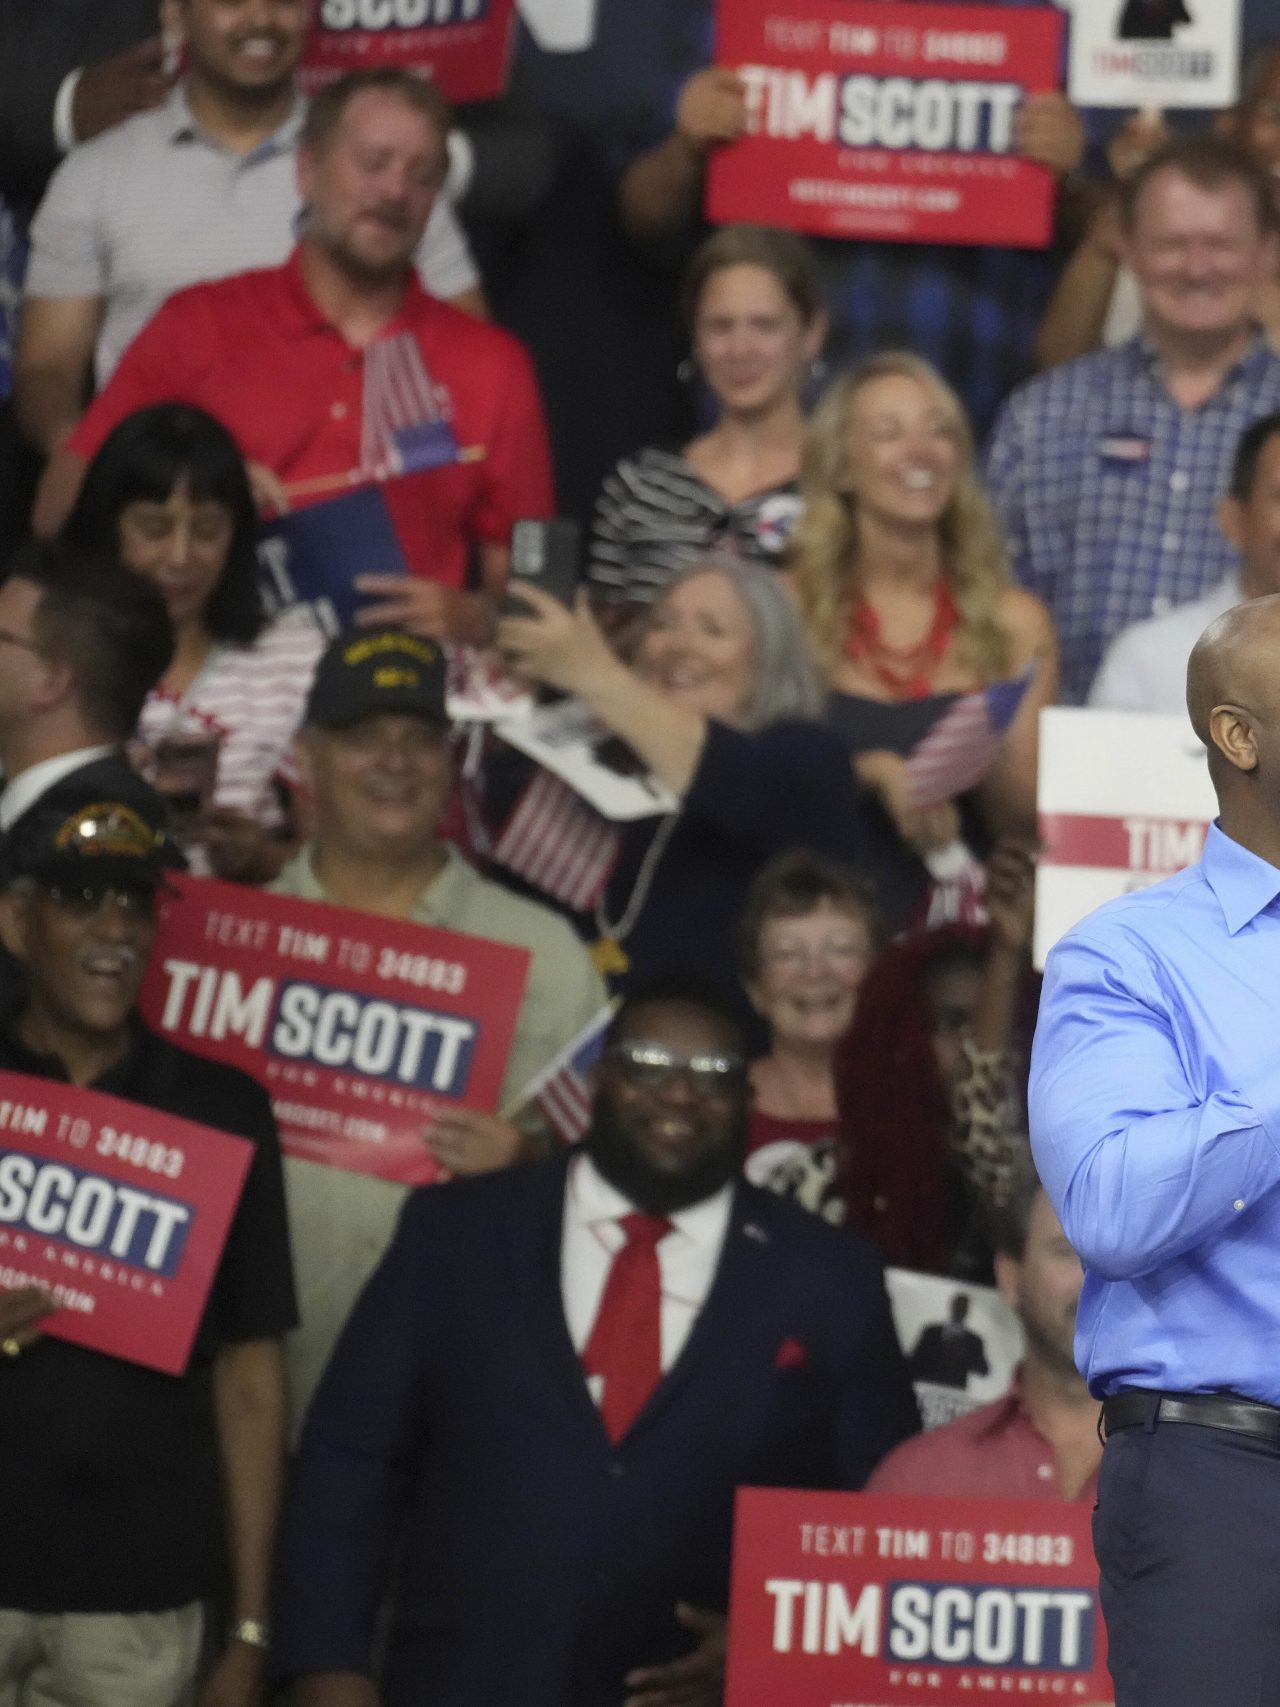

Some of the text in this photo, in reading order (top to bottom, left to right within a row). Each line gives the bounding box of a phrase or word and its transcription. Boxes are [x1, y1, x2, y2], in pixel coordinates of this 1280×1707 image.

[737, 64, 1021, 152] TIM SCOTT
[1123, 816, 1204, 873] TIM
[205, 911, 270, 949] TEXT
[277, 926, 329, 965] TIM
[337, 938, 371, 974] TO
[161, 958, 474, 1091] TIM SCOTT
[56, 1114, 92, 1149] TO
[0, 1153, 190, 1270] SCOTT
[800, 1523, 866, 1557] TEXT
[876, 1527, 929, 1560] TIM
[940, 1530, 974, 1563] TO
[765, 1578, 1092, 1667] TIM SCOTT
[889, 1669, 1088, 1696] FOR AMERICA
